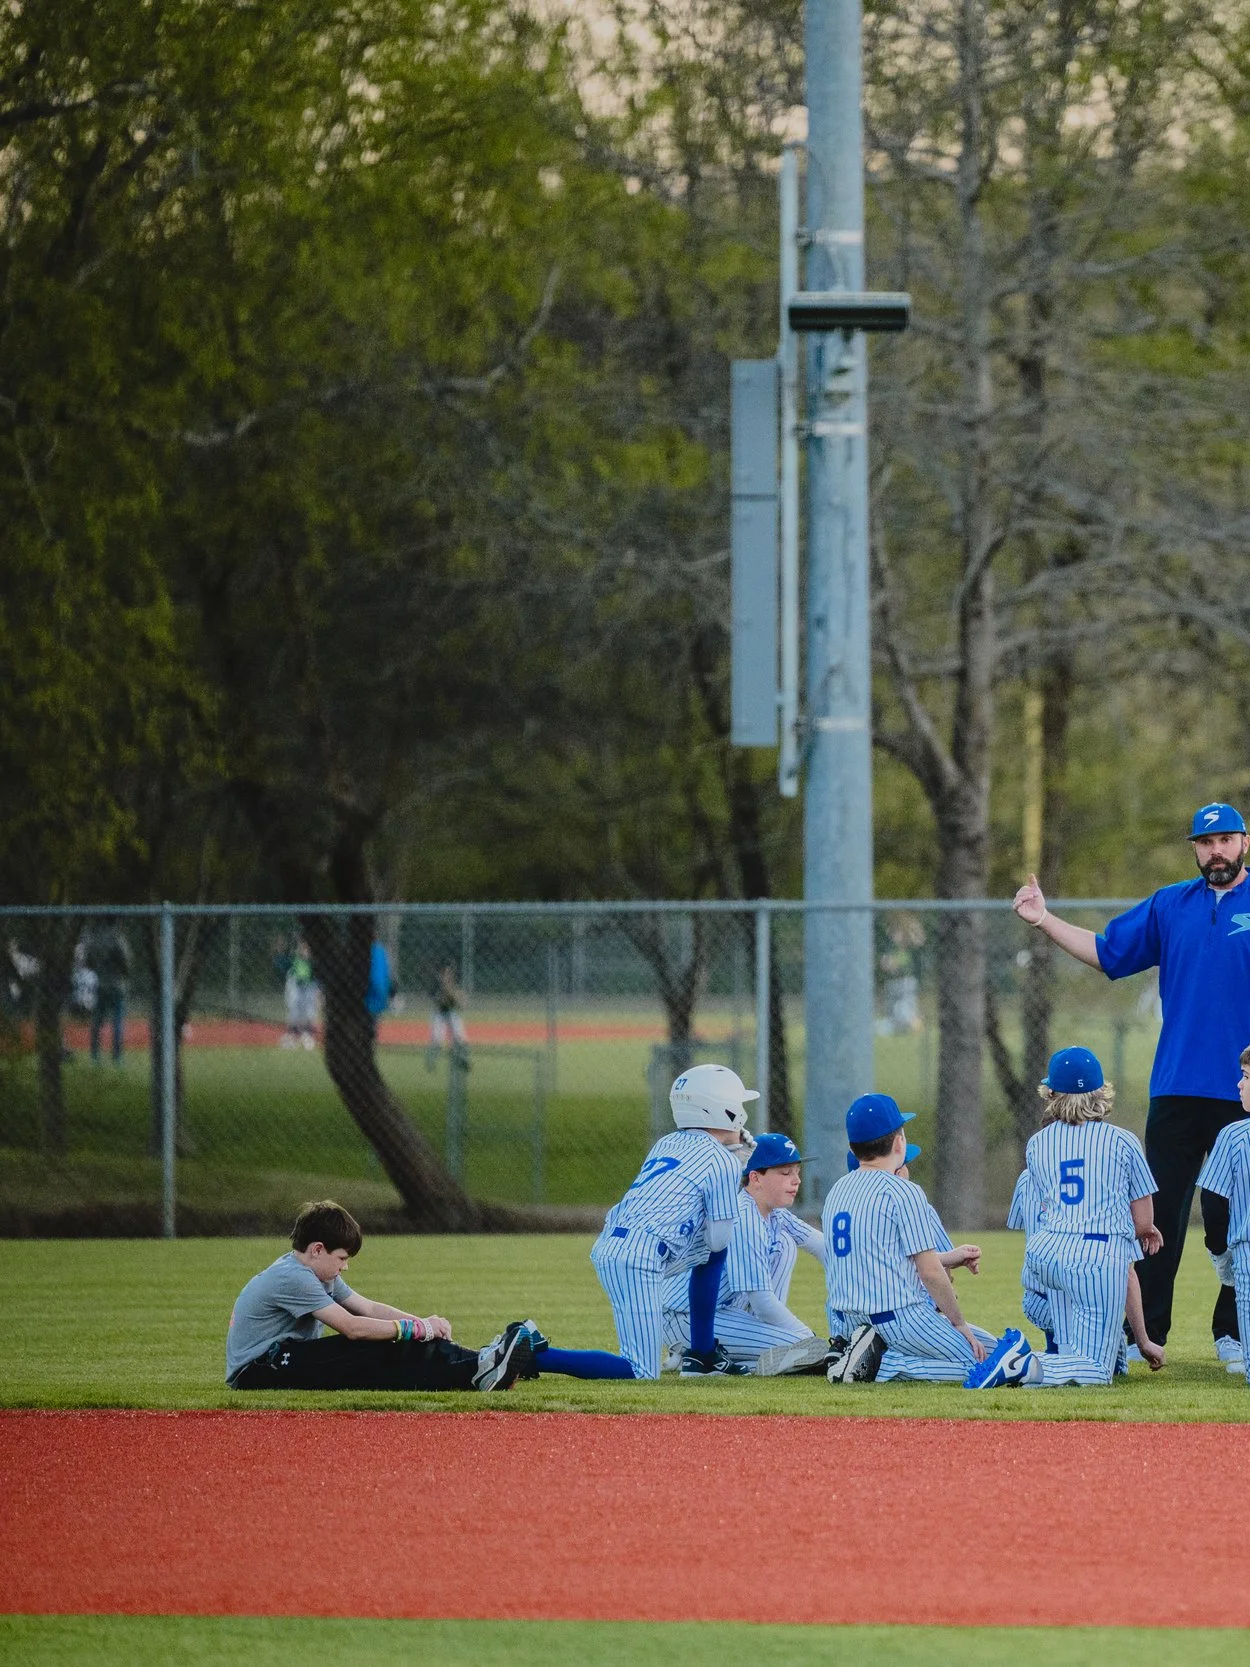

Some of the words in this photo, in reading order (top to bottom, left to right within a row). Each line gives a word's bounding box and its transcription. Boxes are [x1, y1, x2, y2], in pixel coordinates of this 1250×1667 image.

[675, 1078, 688, 1091] 27
[1077, 1079, 1084, 1088] 5
[1060, 1158, 1085, 1205] 5
[832, 1211, 852, 1258] 8
